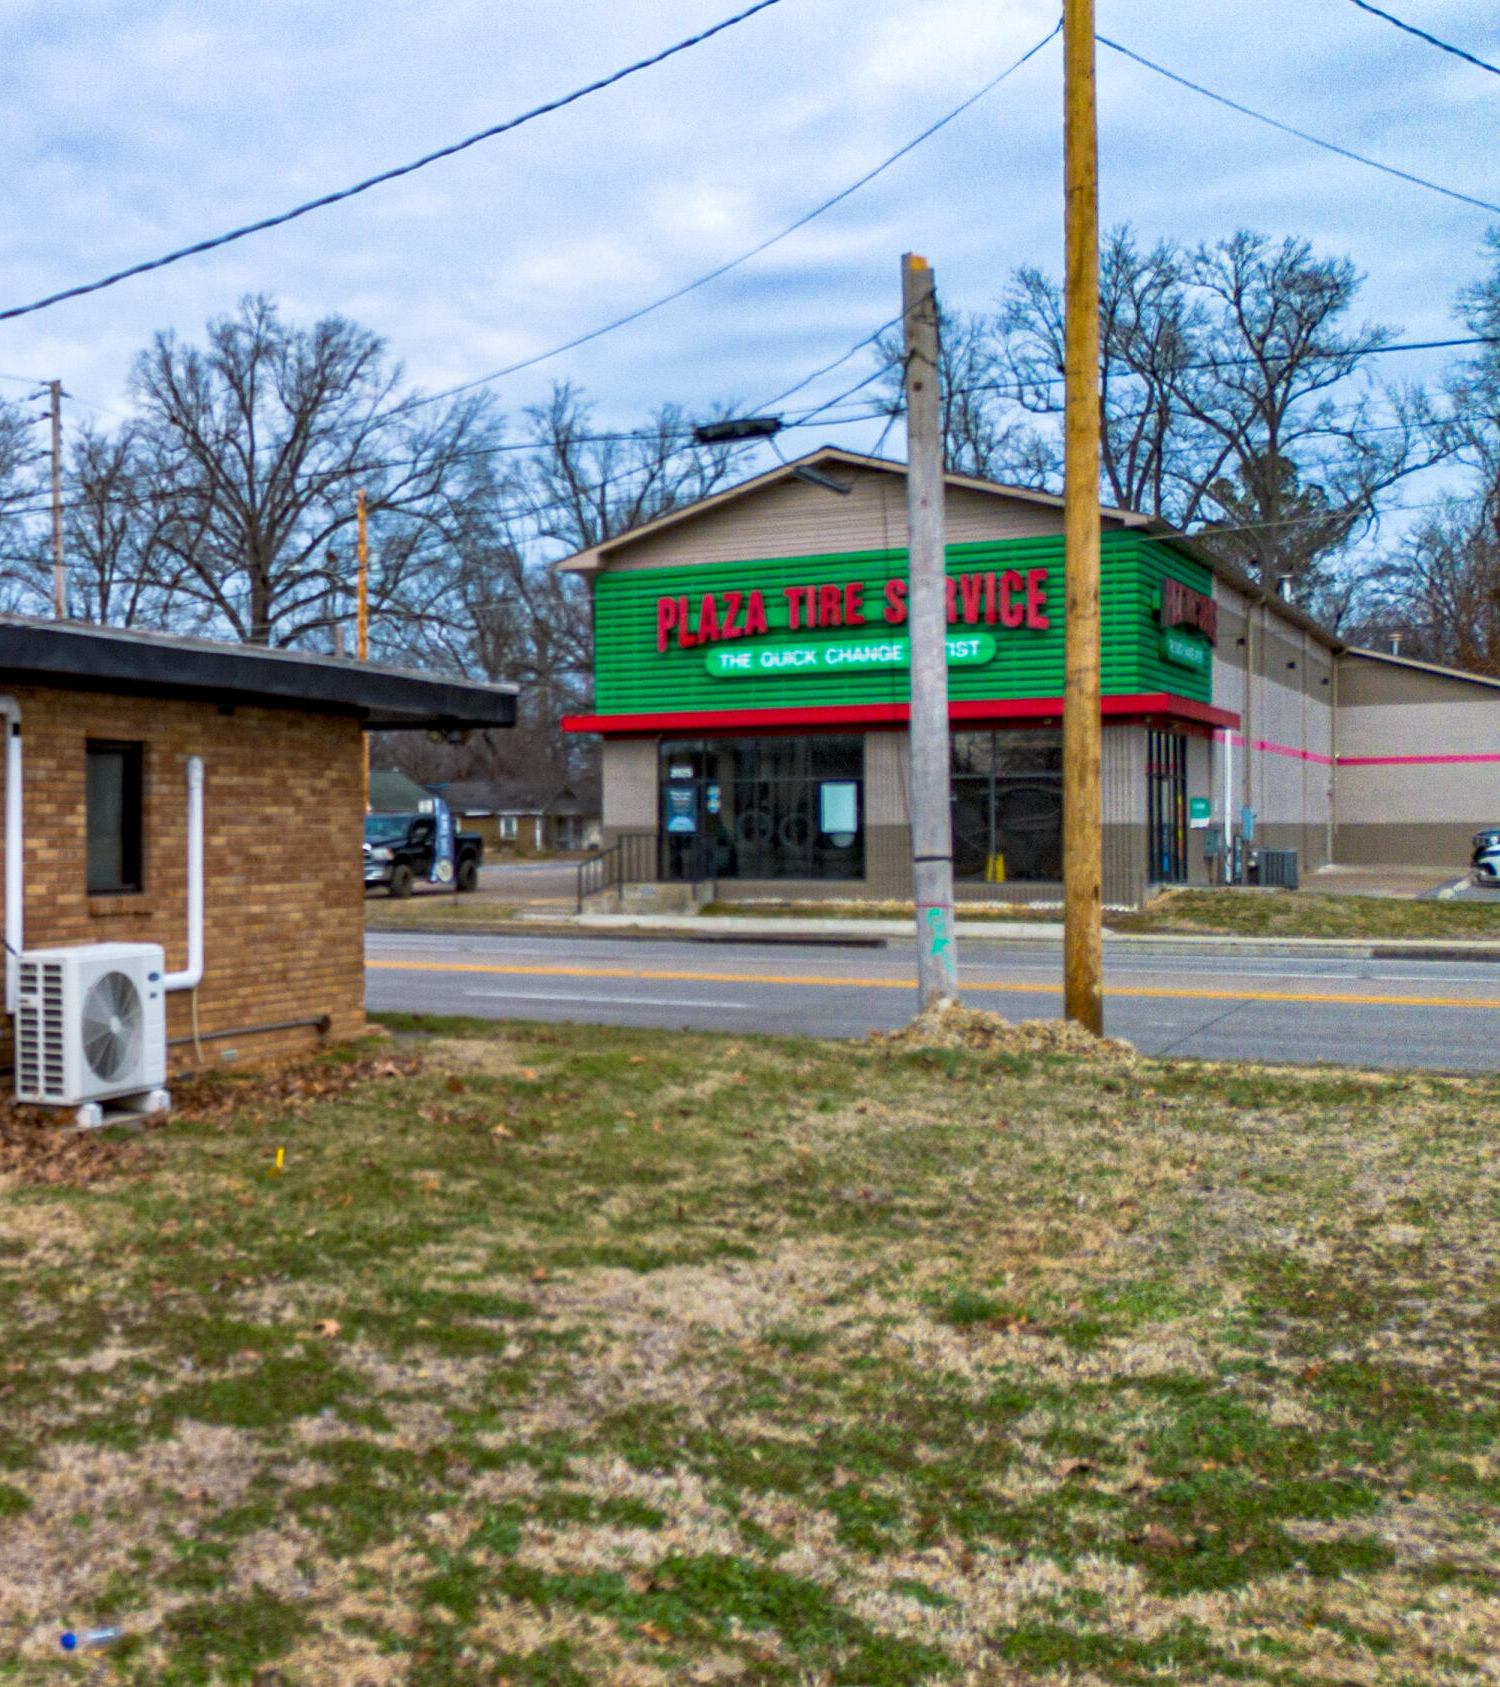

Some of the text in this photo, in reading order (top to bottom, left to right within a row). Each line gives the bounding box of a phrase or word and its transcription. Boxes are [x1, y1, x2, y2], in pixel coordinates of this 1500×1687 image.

[657, 567, 1050, 653] PLAZA TIRE SRVICE
[718, 652, 752, 669] THE
[760, 649, 817, 668] QUICK
[825, 644, 903, 664] CHANGE
